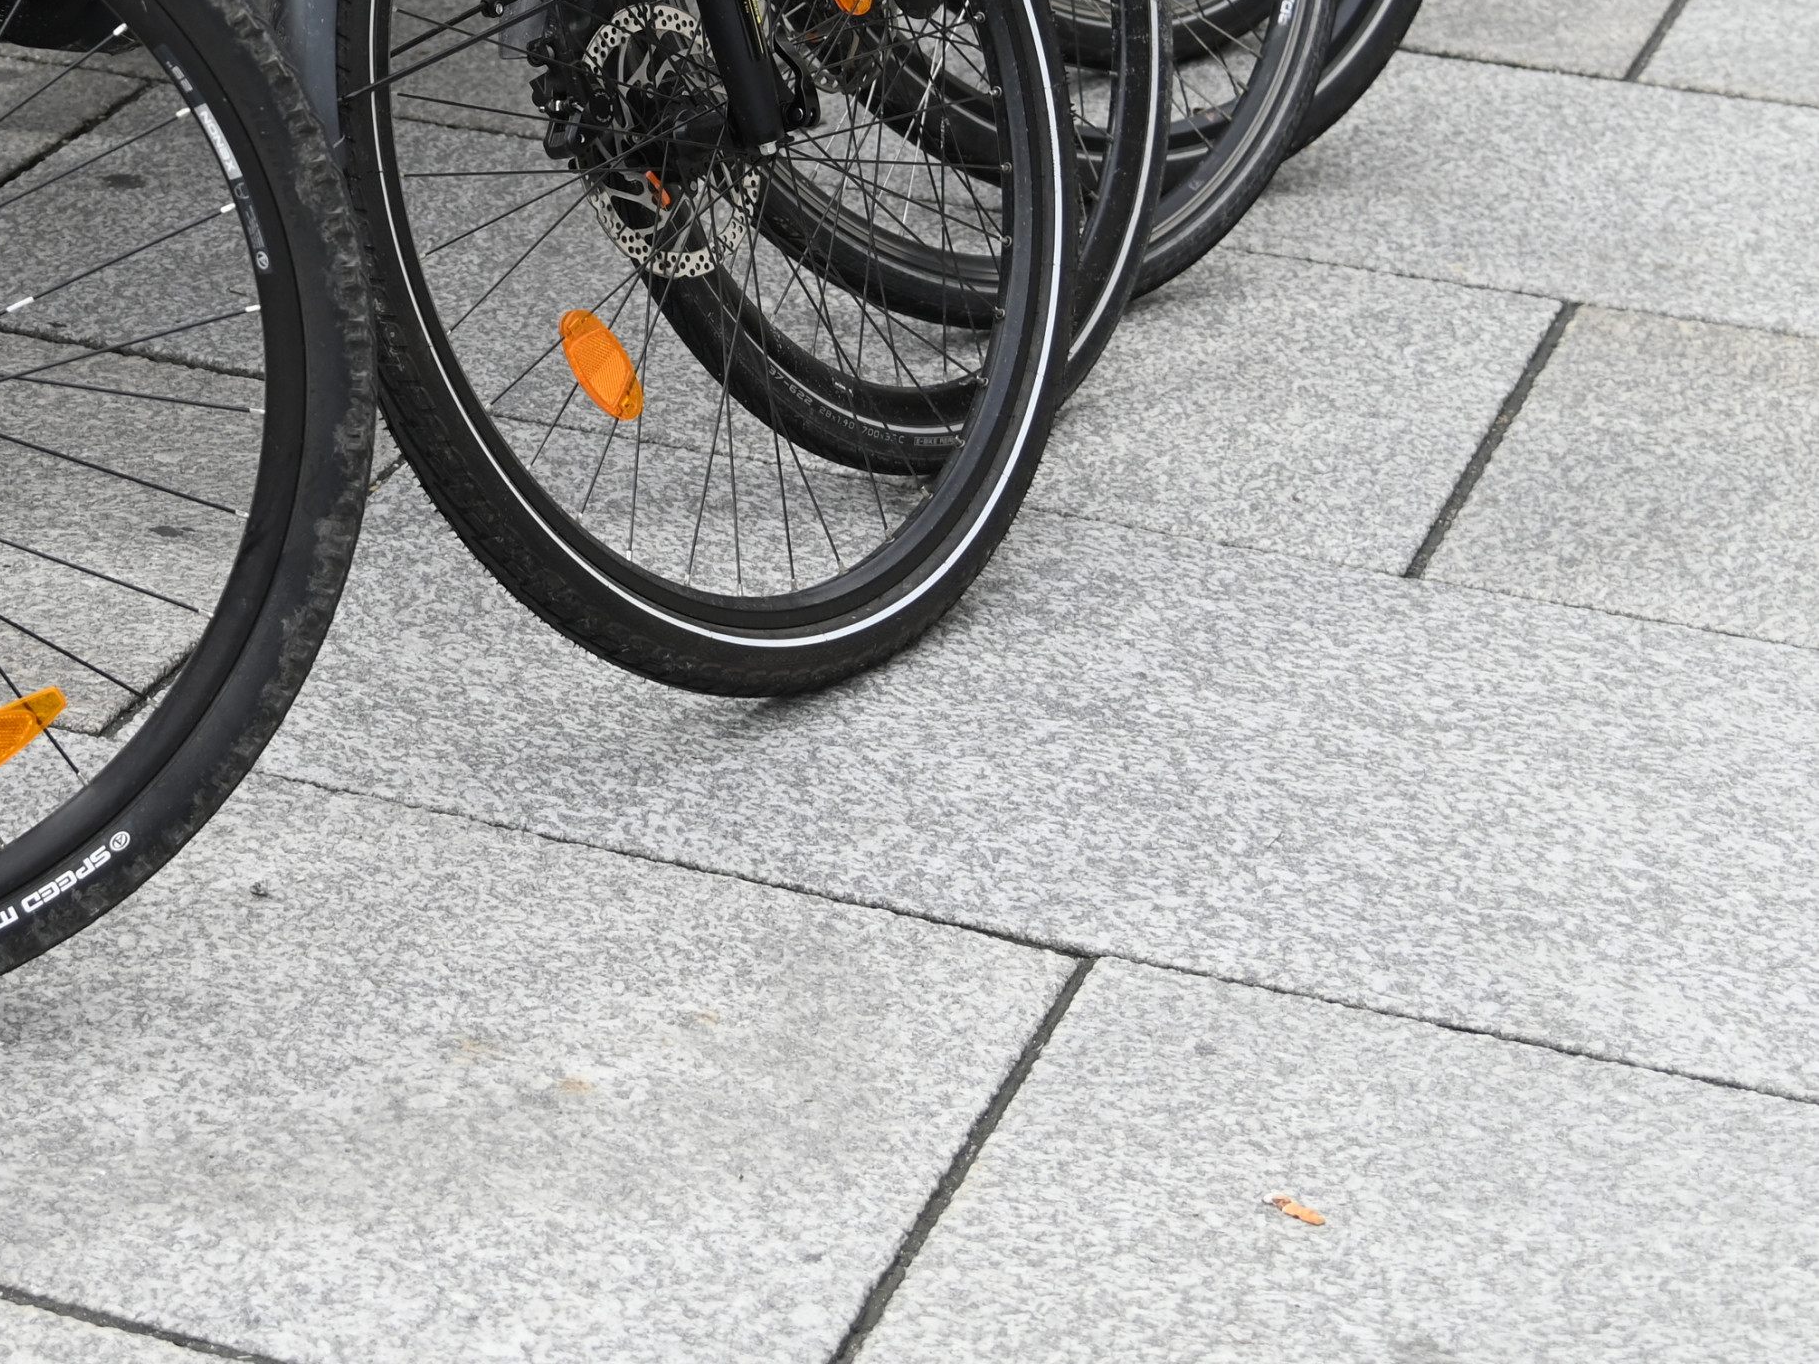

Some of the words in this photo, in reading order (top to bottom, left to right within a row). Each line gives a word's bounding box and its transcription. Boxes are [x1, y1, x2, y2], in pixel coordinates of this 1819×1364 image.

[199, 110, 237, 173] XENON
[768, 365, 813, 406] 37-622
[19, 843, 113, 915] SPEED
